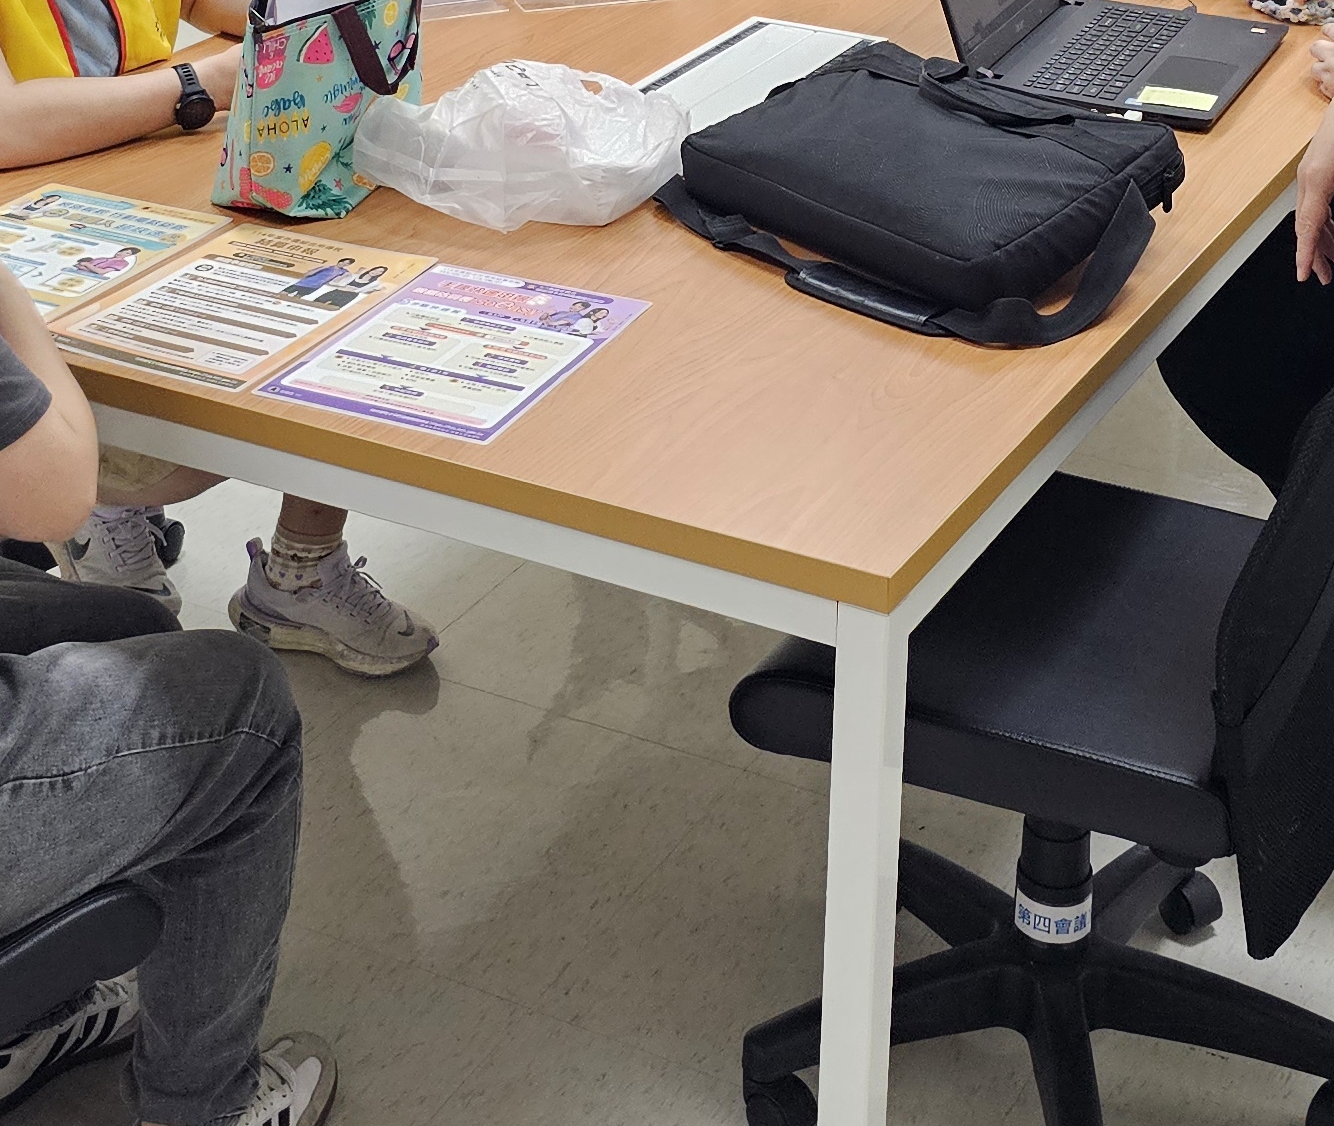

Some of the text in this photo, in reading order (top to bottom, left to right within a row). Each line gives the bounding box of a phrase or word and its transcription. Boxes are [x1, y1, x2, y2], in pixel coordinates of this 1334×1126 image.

[257, 116, 310, 136] ALOHA
[1018, 903, 1091, 935] 第四會議
